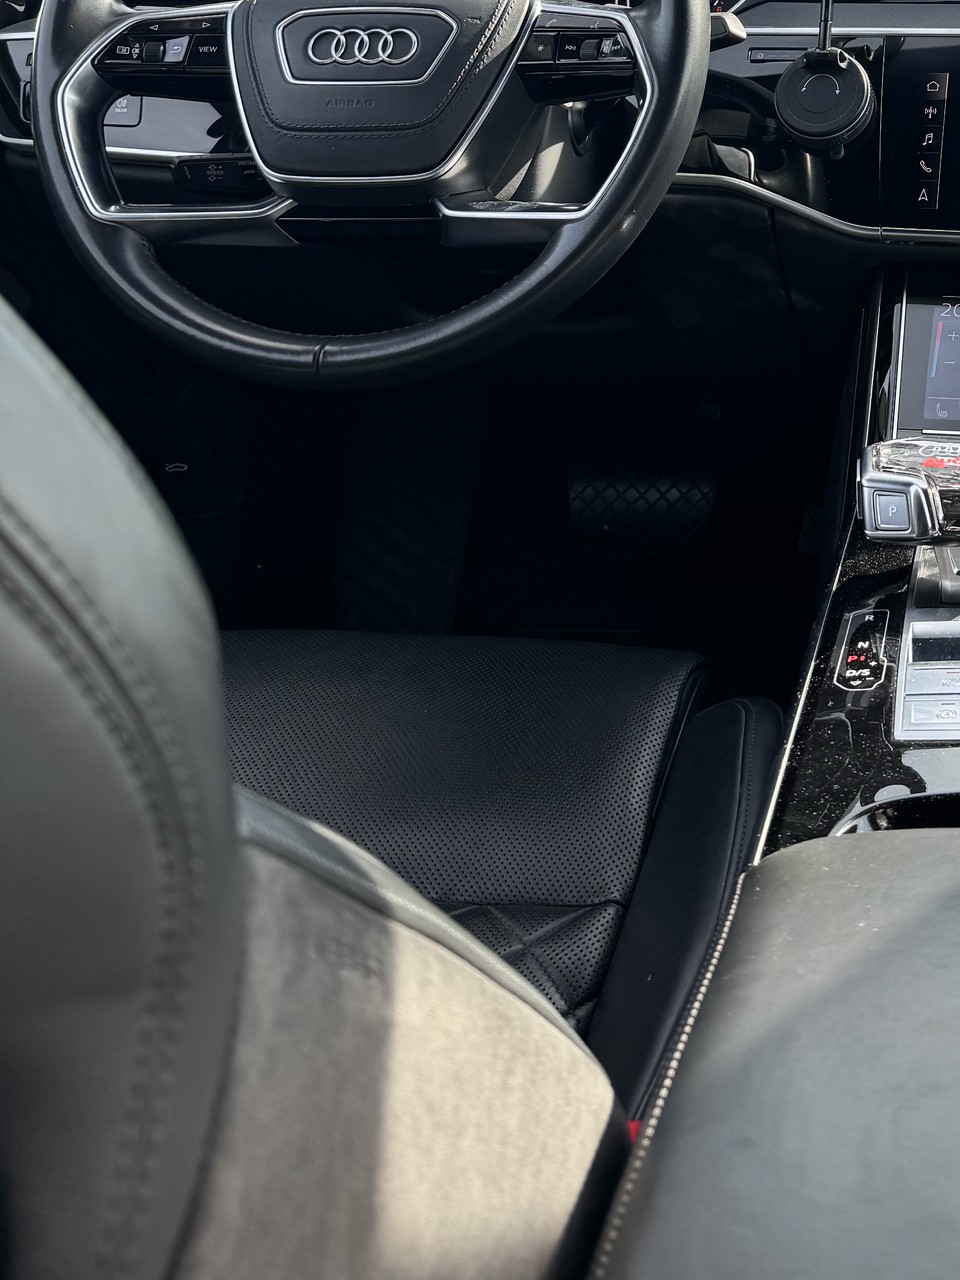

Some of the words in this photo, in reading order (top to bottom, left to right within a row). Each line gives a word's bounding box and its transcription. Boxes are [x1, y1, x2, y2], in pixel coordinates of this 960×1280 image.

[131, 47, 141, 55] OK
[198, 46, 218, 54] VIEW
[889, 505, 897, 517] P
[847, 655, 858, 663] P
[845, 668, 871, 677] D/S
